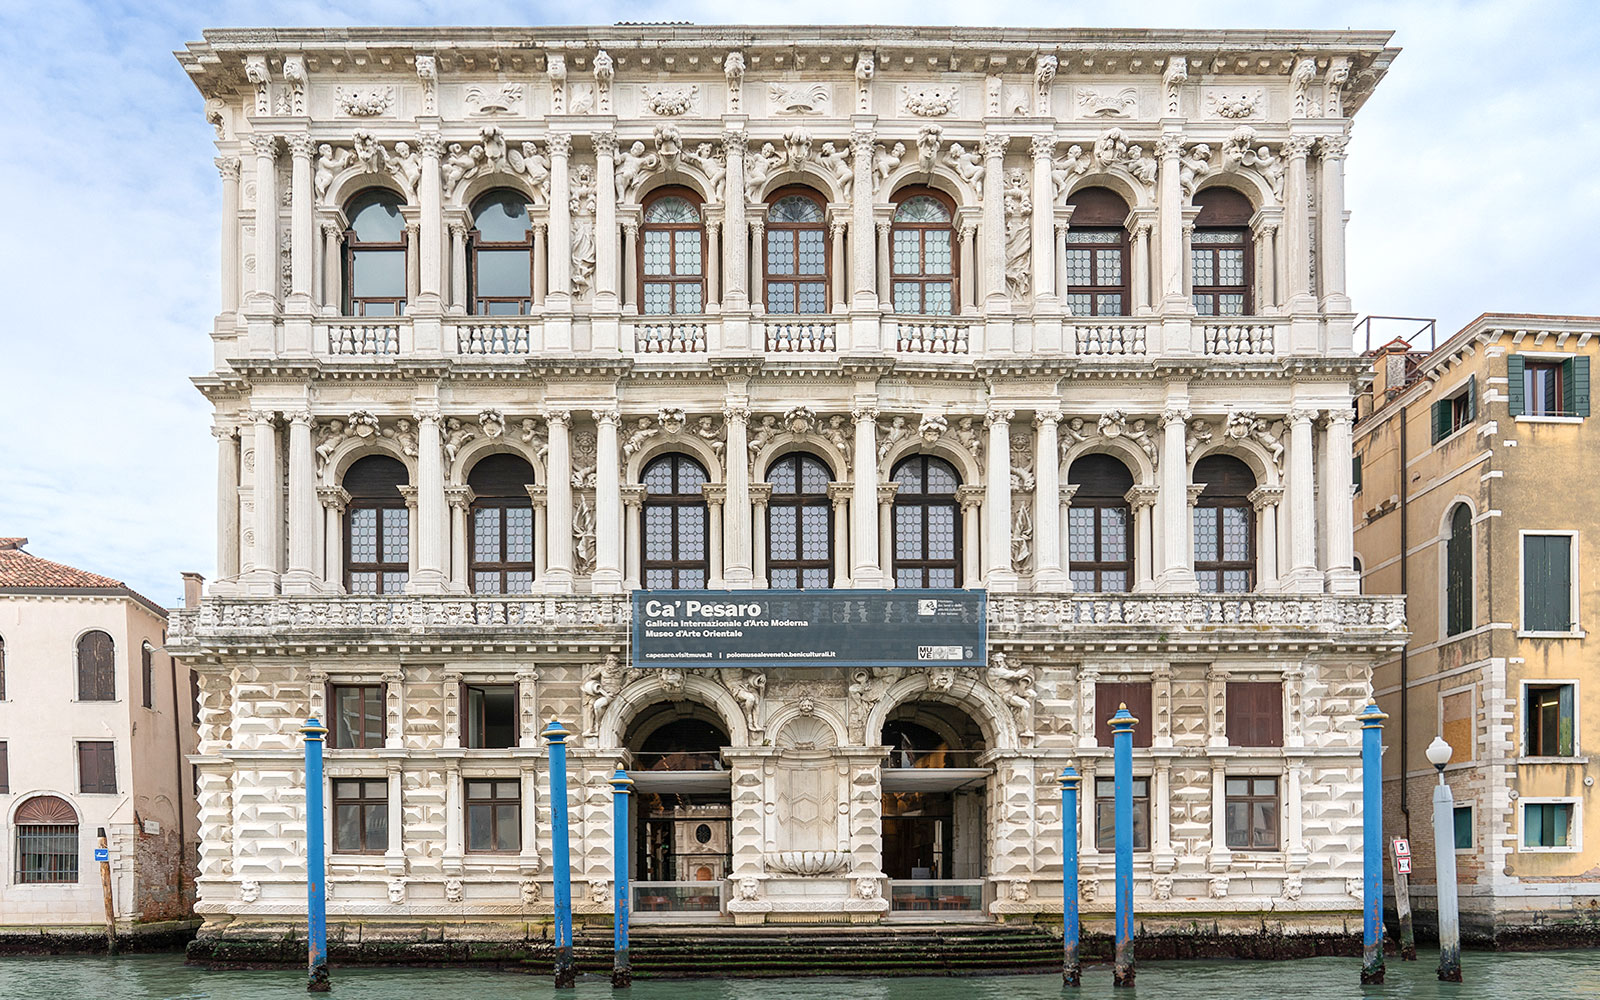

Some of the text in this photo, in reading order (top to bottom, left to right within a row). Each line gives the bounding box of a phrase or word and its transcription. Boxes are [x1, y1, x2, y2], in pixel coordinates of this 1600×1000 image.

[686, 600, 762, 617] Pesaro
[645, 619, 679, 627] Galleria
[680, 619, 742, 627] Internazionale
[770, 619, 809, 627] Moderna
[645, 630, 674, 638] Museo
[703, 629, 743, 638] Orientale
